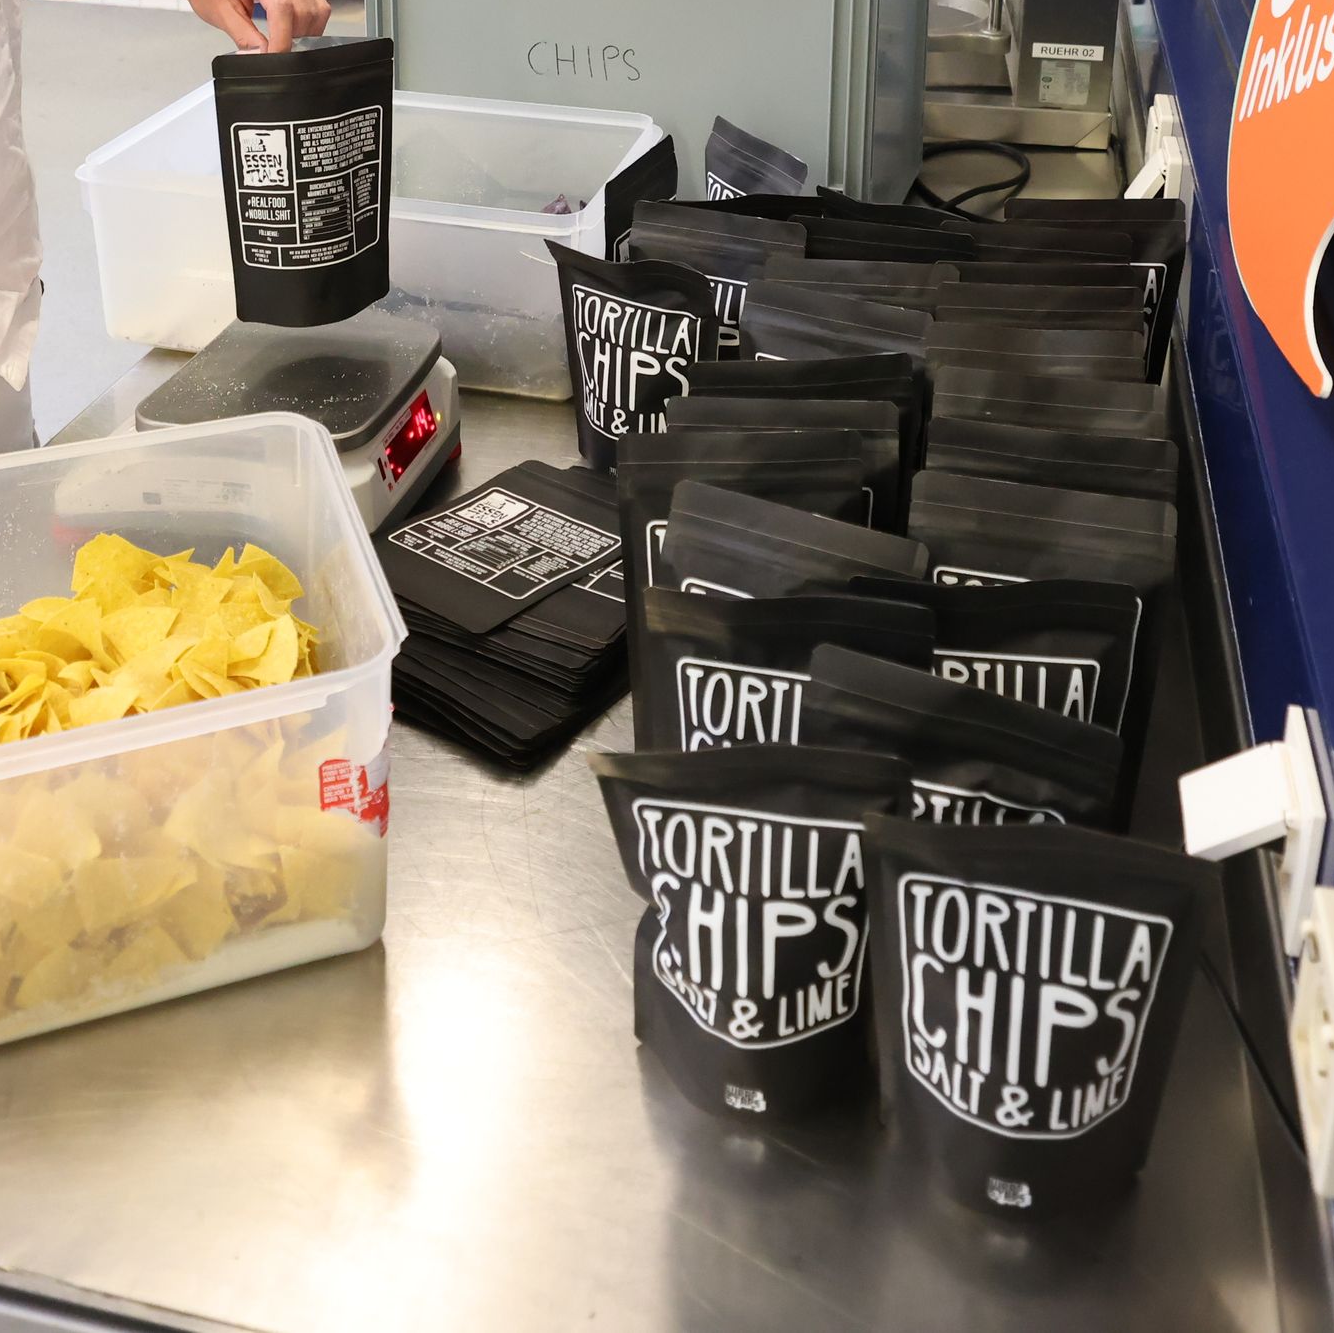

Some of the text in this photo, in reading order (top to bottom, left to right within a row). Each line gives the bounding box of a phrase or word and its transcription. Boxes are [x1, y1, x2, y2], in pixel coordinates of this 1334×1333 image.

[527, 41, 641, 81] CHIPS
[1040, 46, 1095, 57] RUEHR 02
[244, 154, 281, 168] ESSEN
[245, 209, 291, 221] #NOBULLSHIT
[247, 196, 286, 208] #REALFOOD
[576, 290, 692, 356] TORTILLA
[579, 331, 690, 412] CHIPS
[586, 385, 606, 429] SALT
[610, 408, 630, 434] &
[642, 809, 865, 899] TORTILLA
[651, 872, 859, 1000] CHIPS
[910, 884, 1151, 990] TORTILLA
[728, 999, 764, 1040] &
[778, 973, 852, 1037] LIME
[912, 952, 1141, 1089] CHIPS
[912, 1032, 1126, 1130] SALT & LIME
